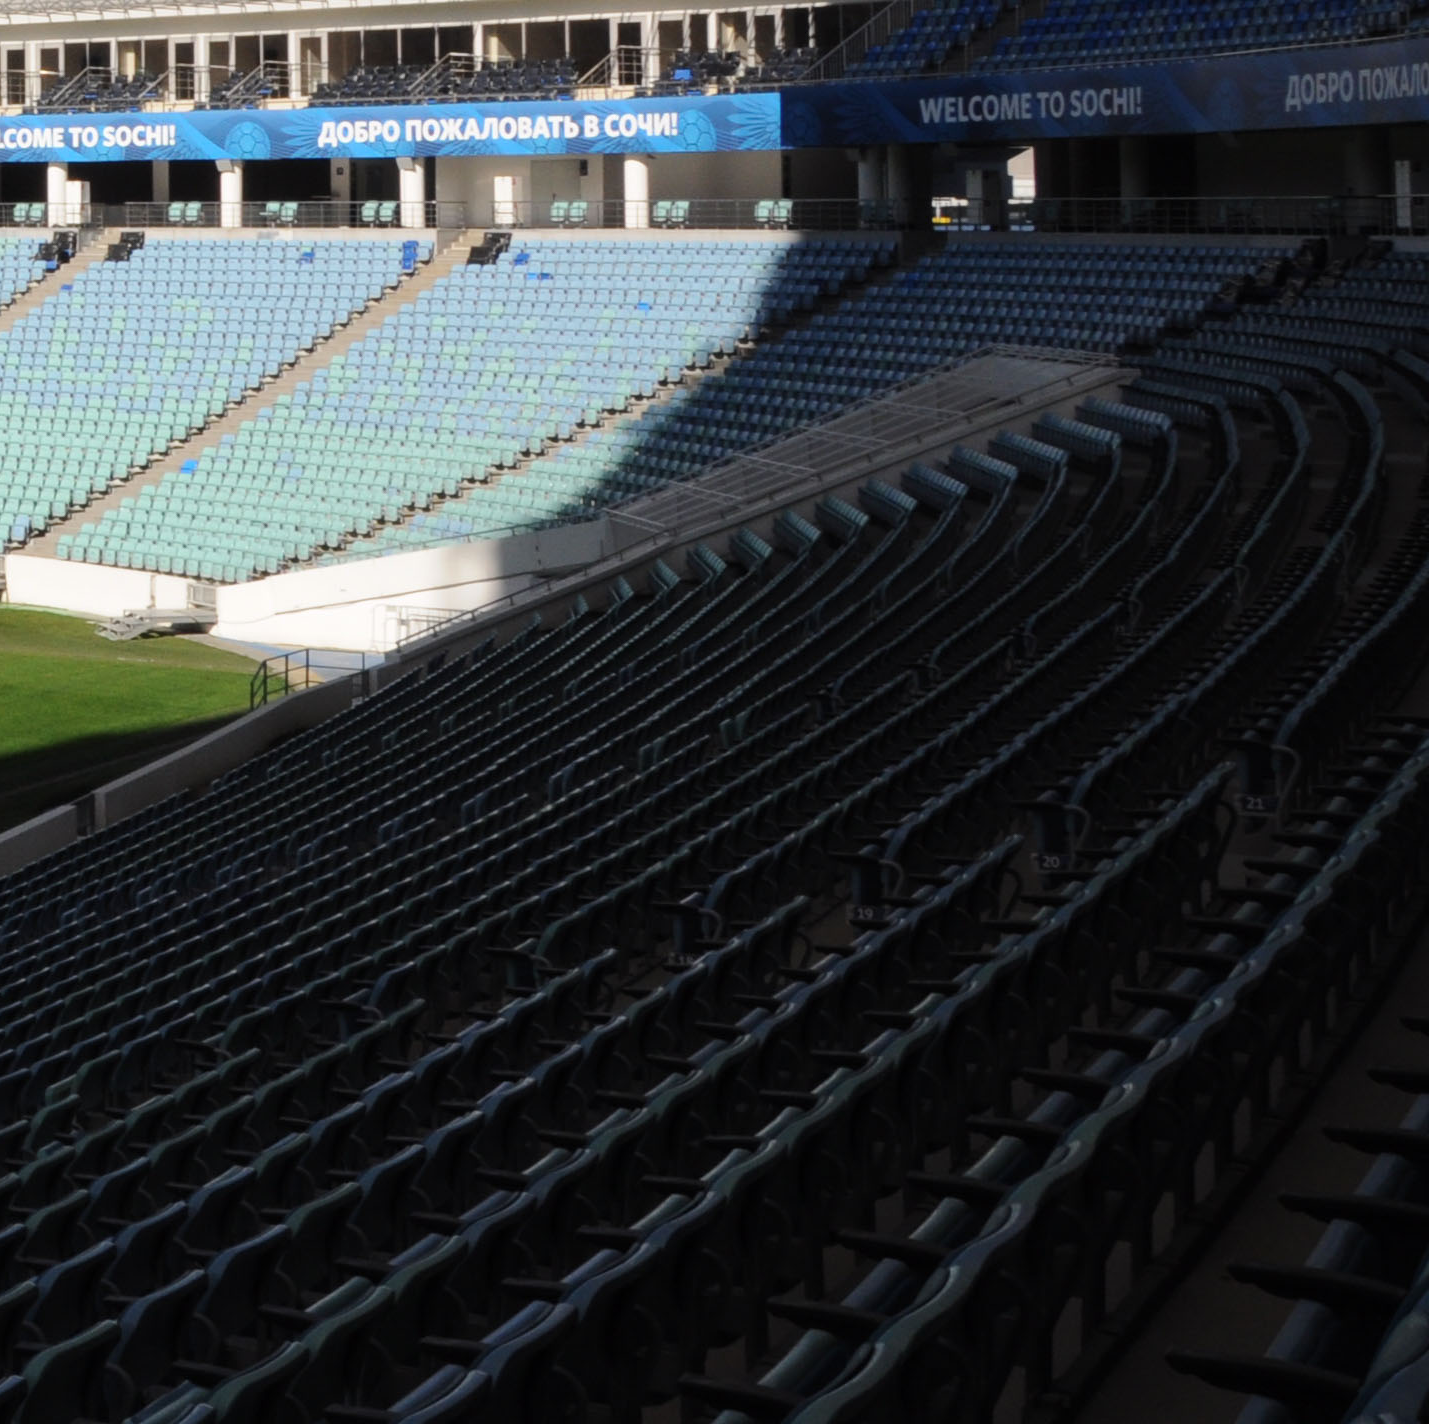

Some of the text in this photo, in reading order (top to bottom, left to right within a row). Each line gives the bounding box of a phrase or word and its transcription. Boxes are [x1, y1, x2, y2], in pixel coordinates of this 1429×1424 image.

[1285, 70, 1354, 112] ДОБРО
[919, 86, 1142, 124] WELCOME TO SOCHI!
[68, 126, 98, 147] TO
[102, 125, 176, 147] SOCHI!
[317, 112, 679, 148] ДОБРО ПОЖАЛОВАТЬ В СОЧИ!
[1245, 796, 1264, 810] 21
[1041, 855, 1060, 869] 20
[857, 907, 874, 919] 19
